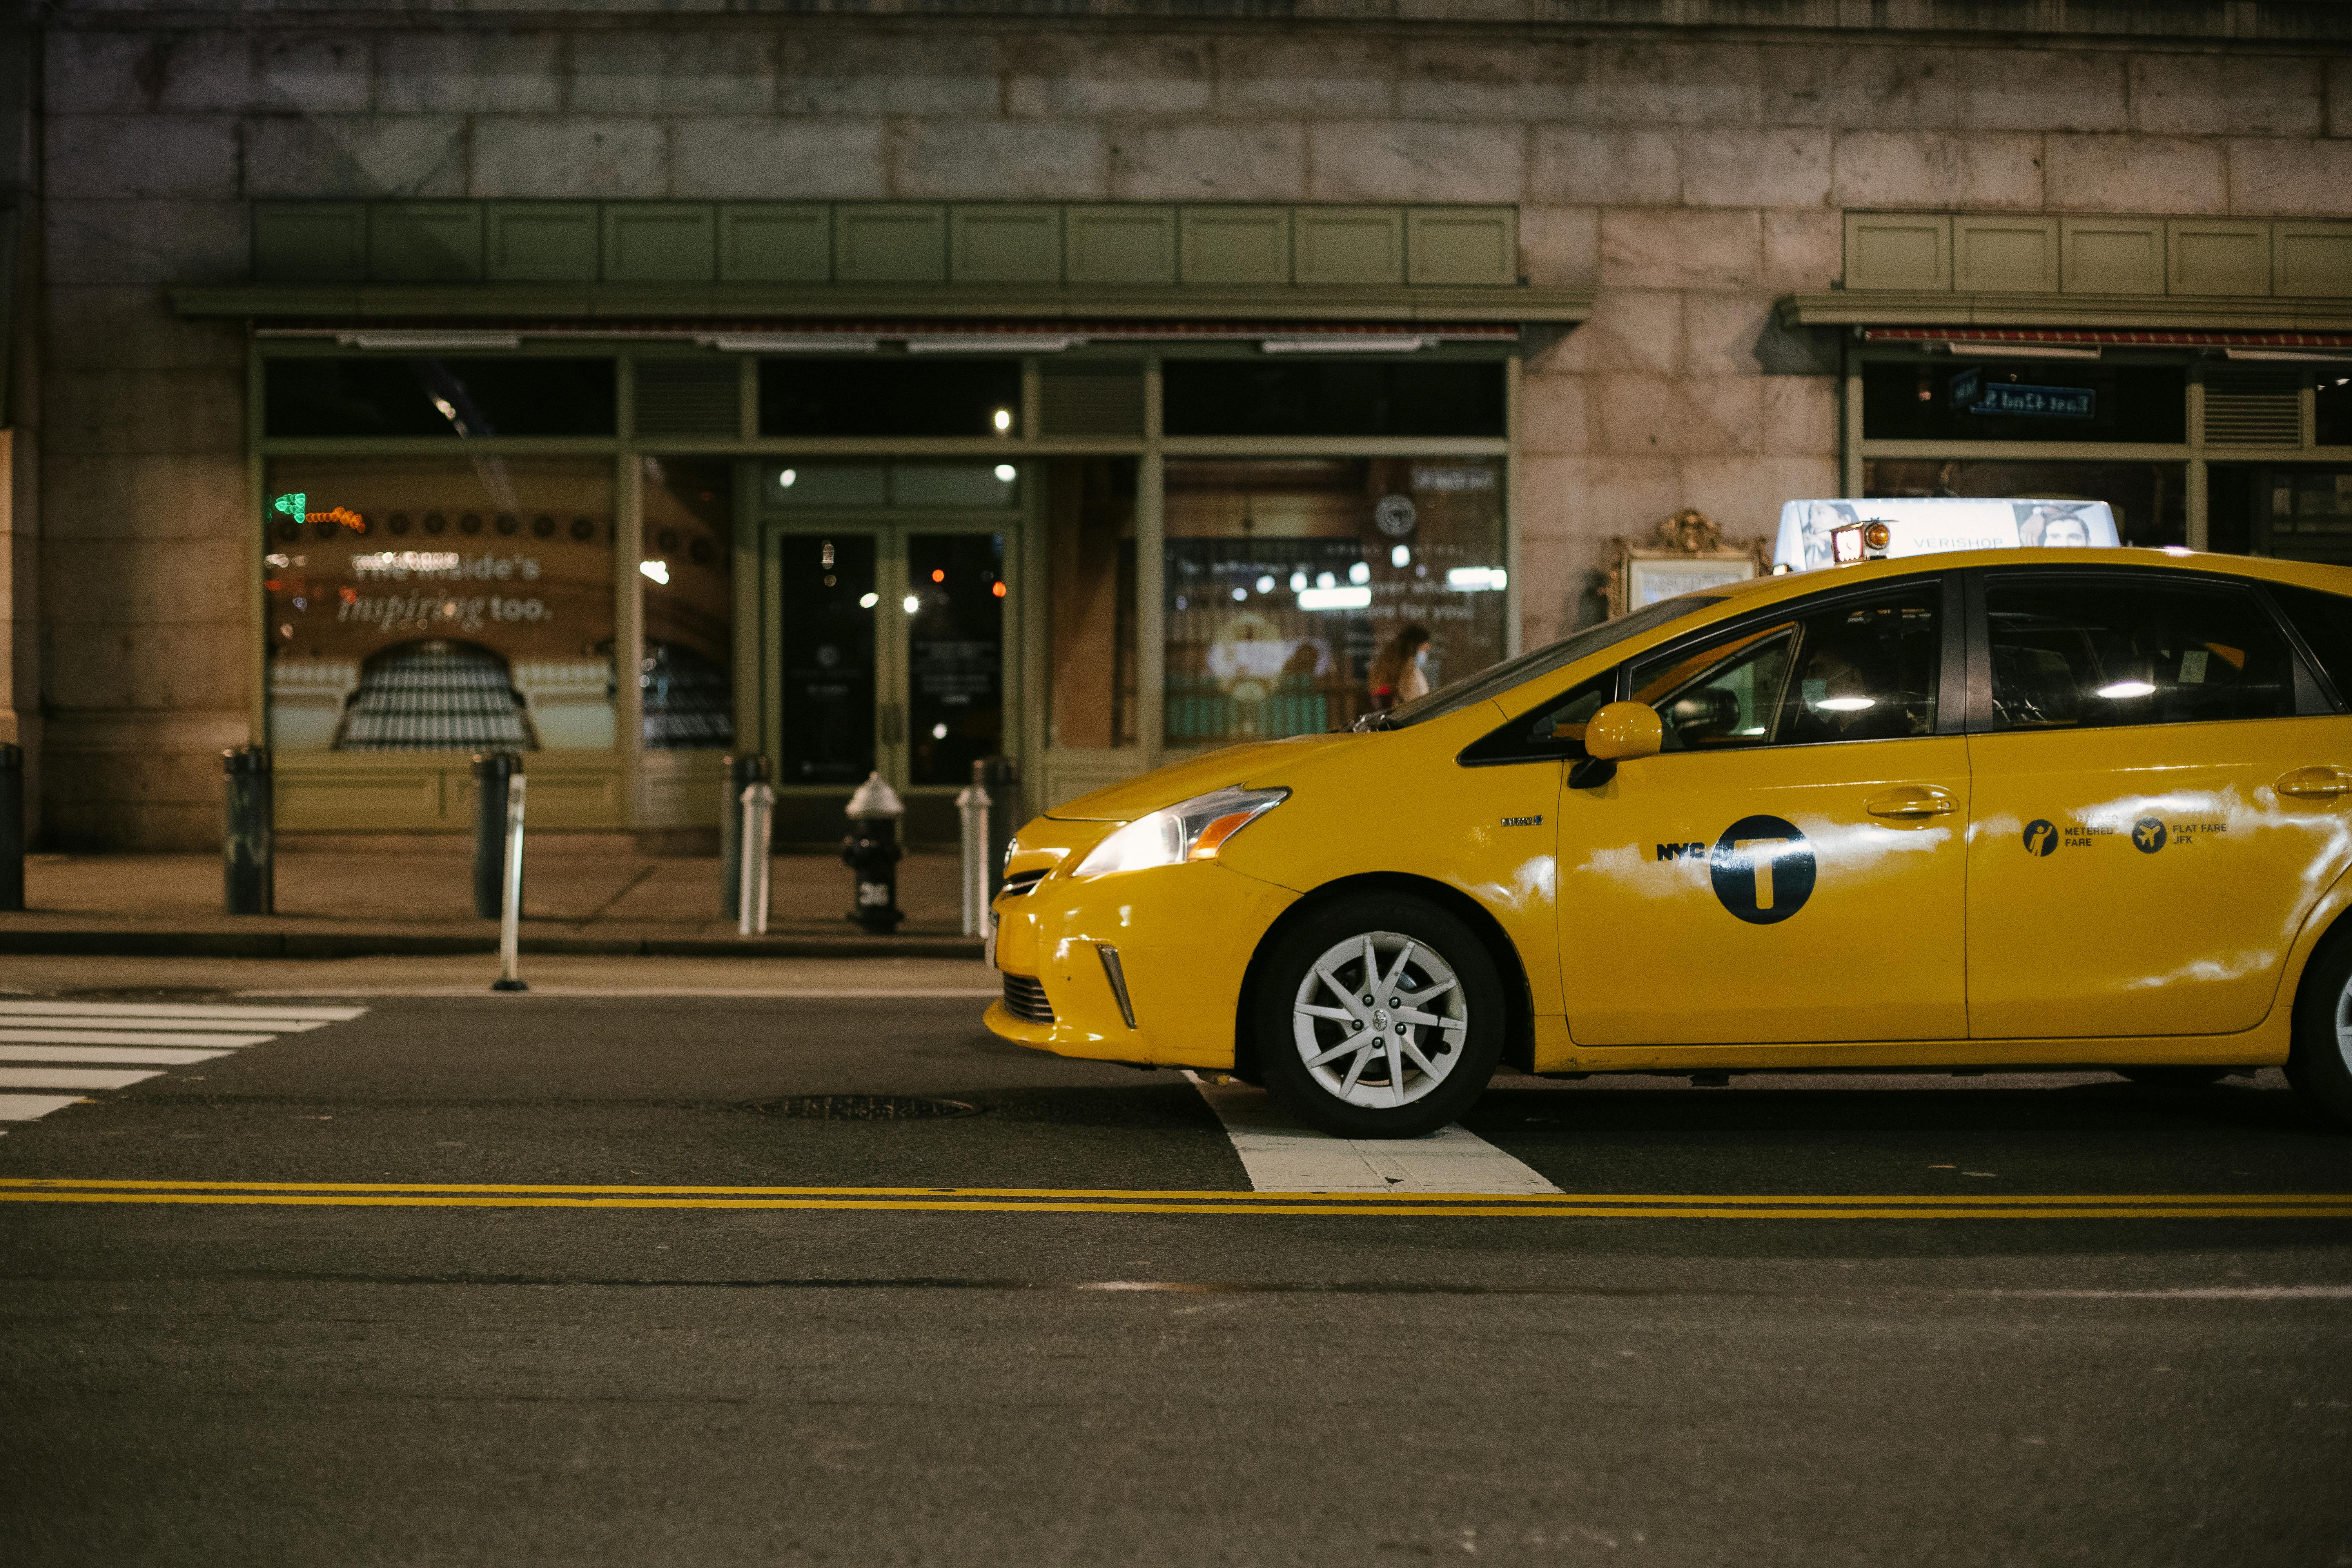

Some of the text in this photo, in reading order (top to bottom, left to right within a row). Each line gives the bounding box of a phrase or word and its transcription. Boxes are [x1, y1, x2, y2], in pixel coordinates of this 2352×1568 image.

[1914, 538, 2004, 549] VERISHOP
[2064, 827, 2114, 836] METERED
[2172, 823, 2227, 833] FLAT FARE
[2065, 838, 2092, 847] FARE
[2173, 835, 2193, 844] JFK
[1657, 837, 1789, 910] NYC T
